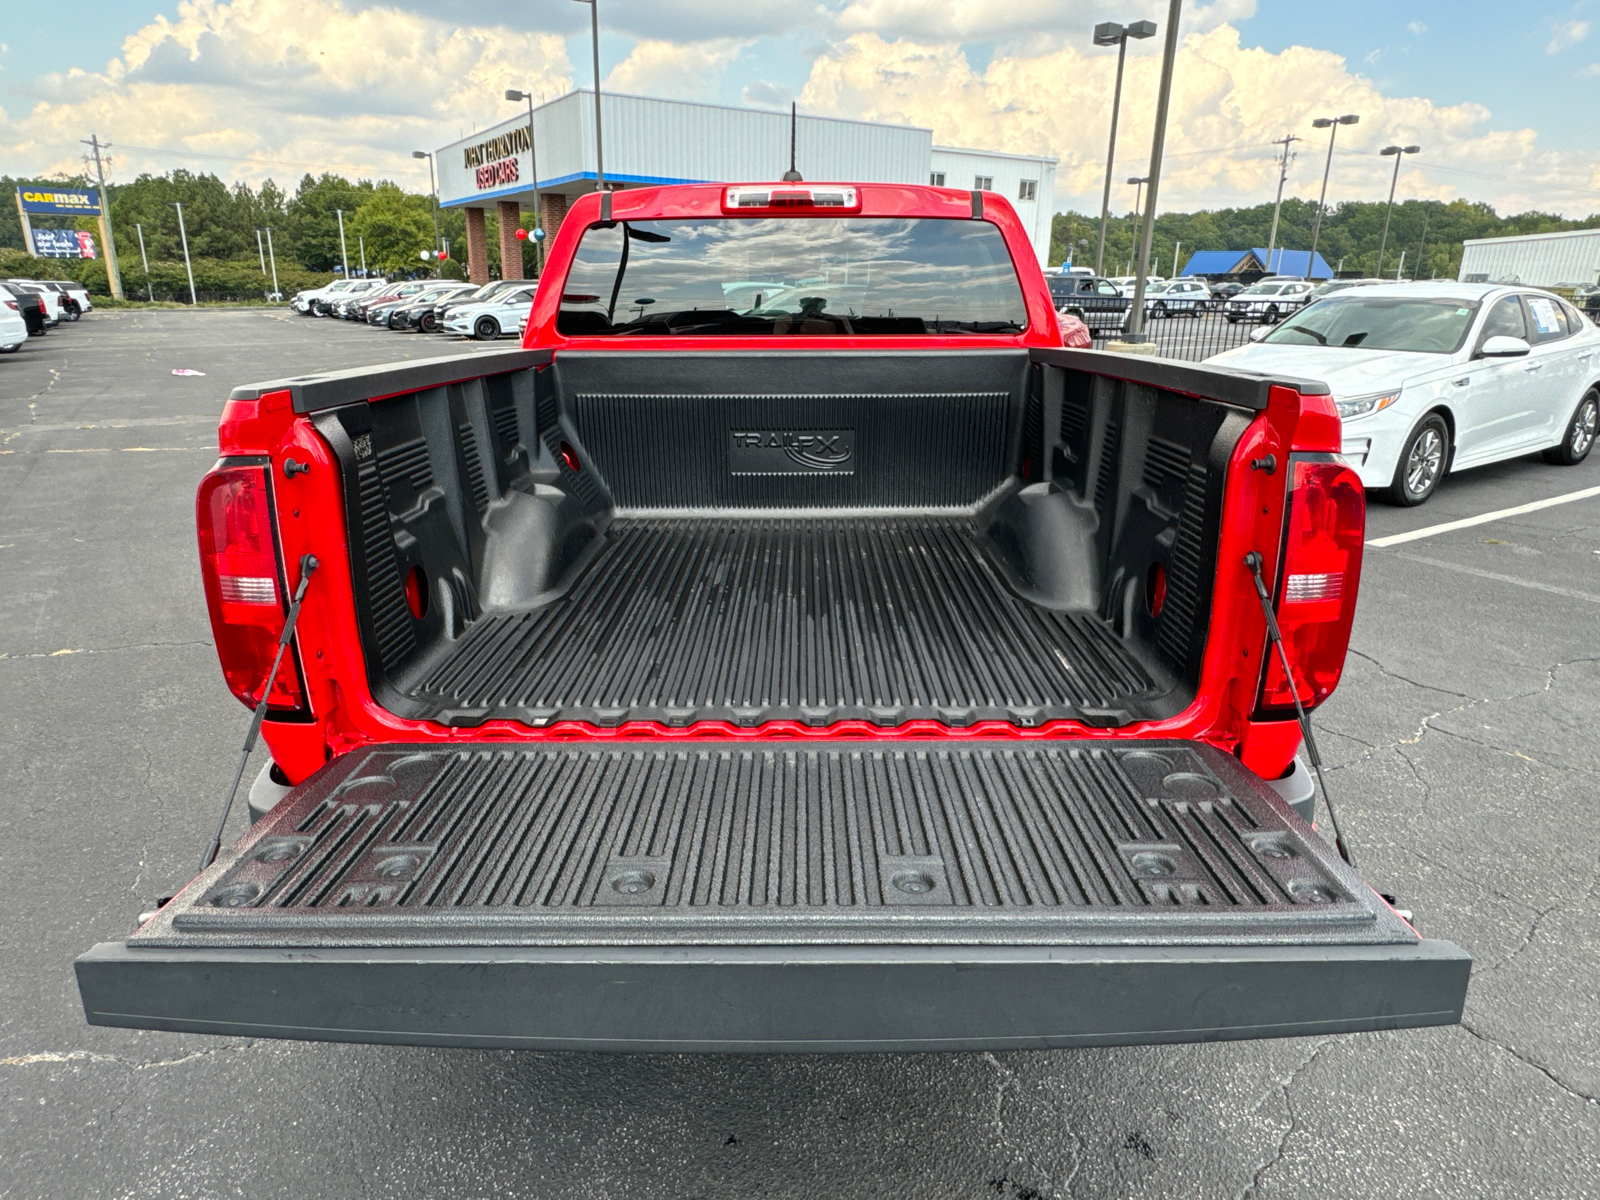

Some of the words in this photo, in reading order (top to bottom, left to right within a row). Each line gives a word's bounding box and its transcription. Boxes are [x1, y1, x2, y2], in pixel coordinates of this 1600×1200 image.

[482, 124, 532, 163] THORNTON
[476, 165, 496, 189] USED
[495, 157, 519, 185] CARS
